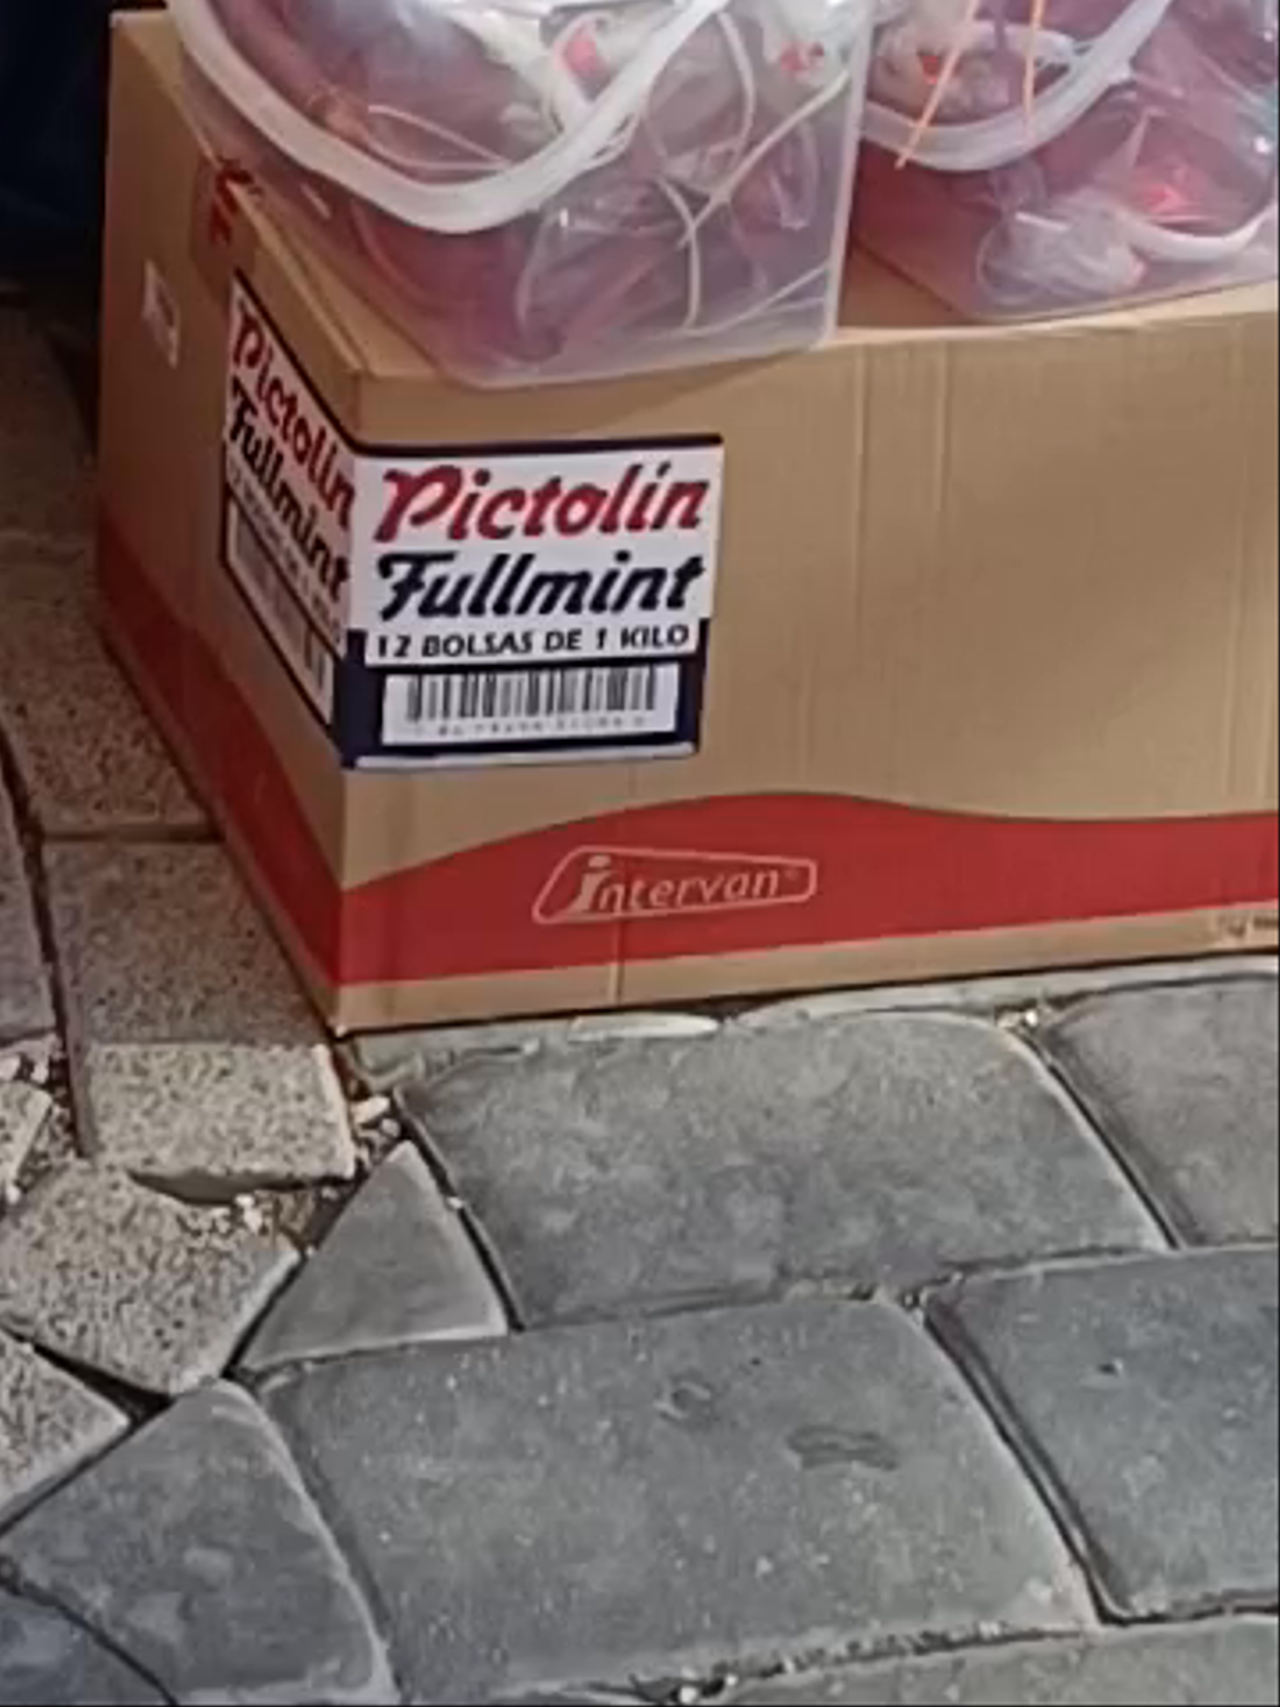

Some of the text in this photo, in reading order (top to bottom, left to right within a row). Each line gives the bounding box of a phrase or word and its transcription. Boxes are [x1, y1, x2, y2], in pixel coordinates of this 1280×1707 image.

[229, 376, 350, 604] Fullmint
[377, 549, 705, 621] Fullmint
[377, 624, 689, 657] 12 BOLSAS DE 1 KILO
